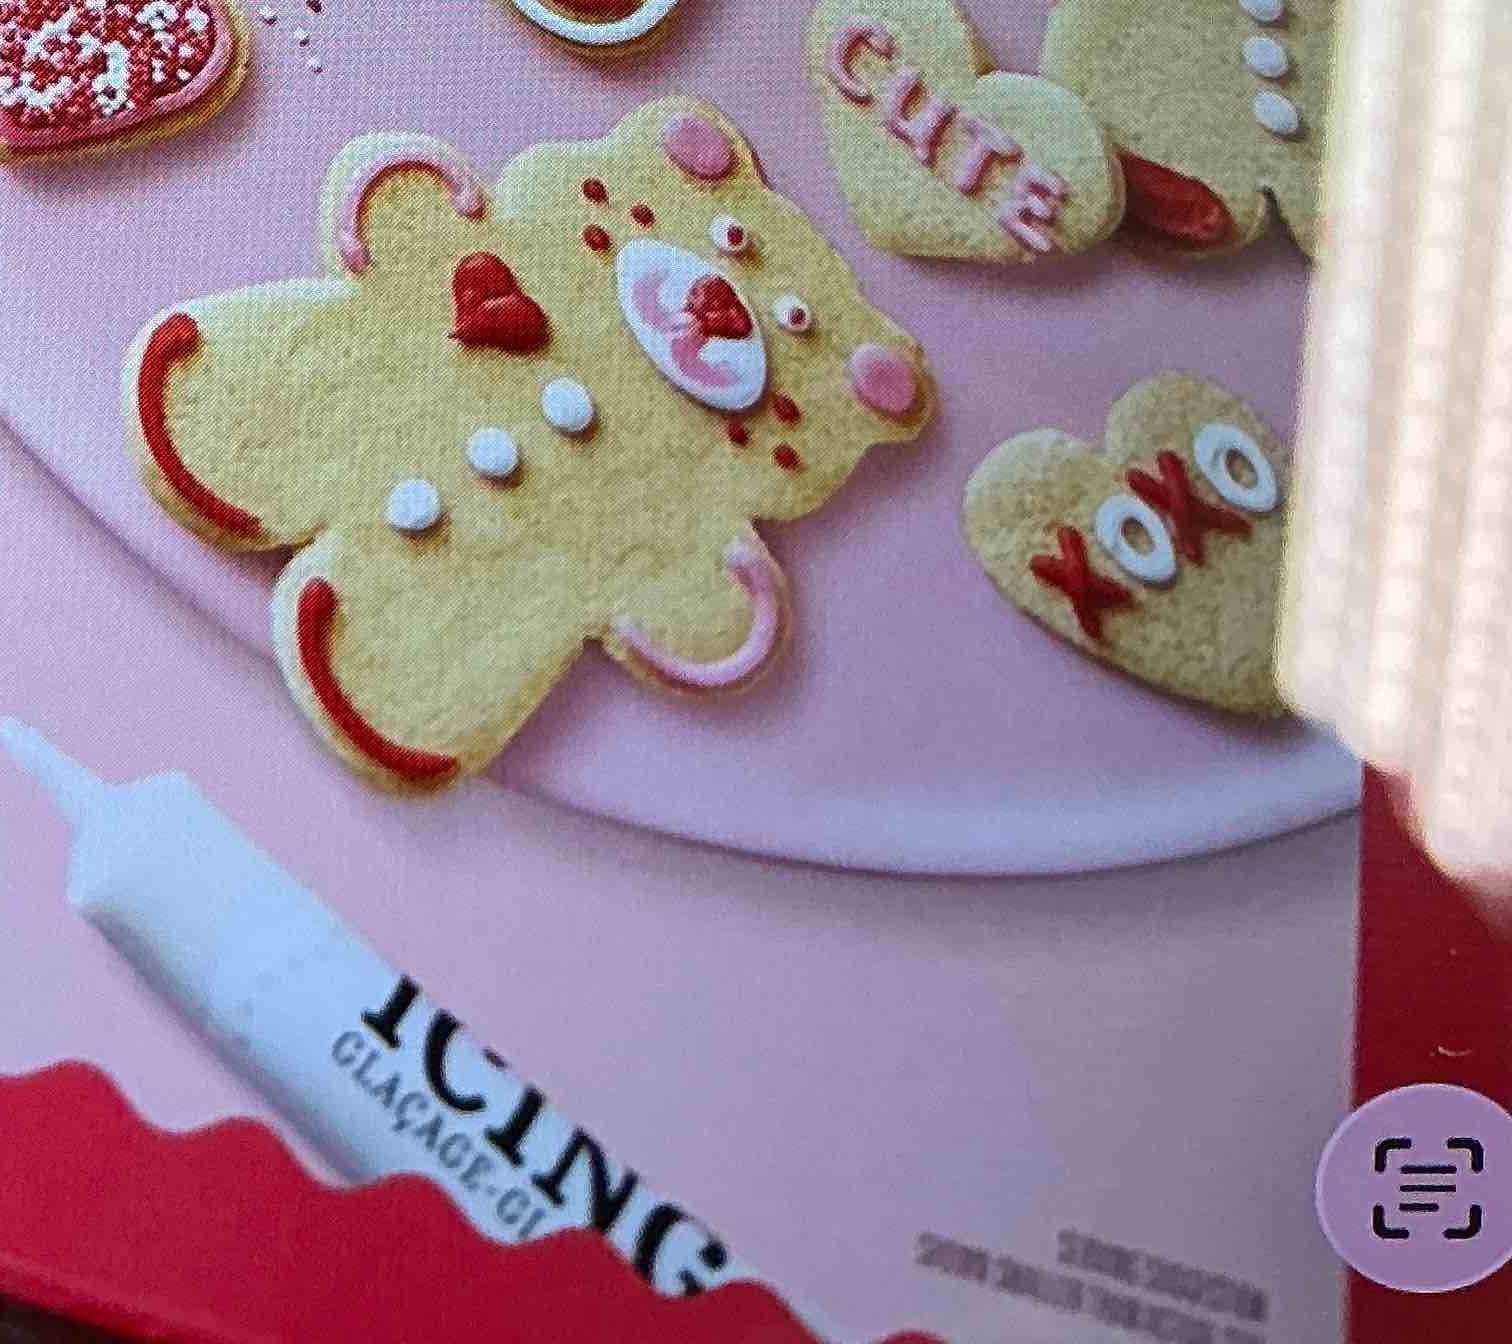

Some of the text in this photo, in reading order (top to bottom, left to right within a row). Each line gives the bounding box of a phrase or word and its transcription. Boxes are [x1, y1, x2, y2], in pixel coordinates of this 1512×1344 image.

[829, 14, 1071, 255] CUTE
[1029, 421, 1279, 640] XOXO
[361, 973, 728, 1298] ICING
